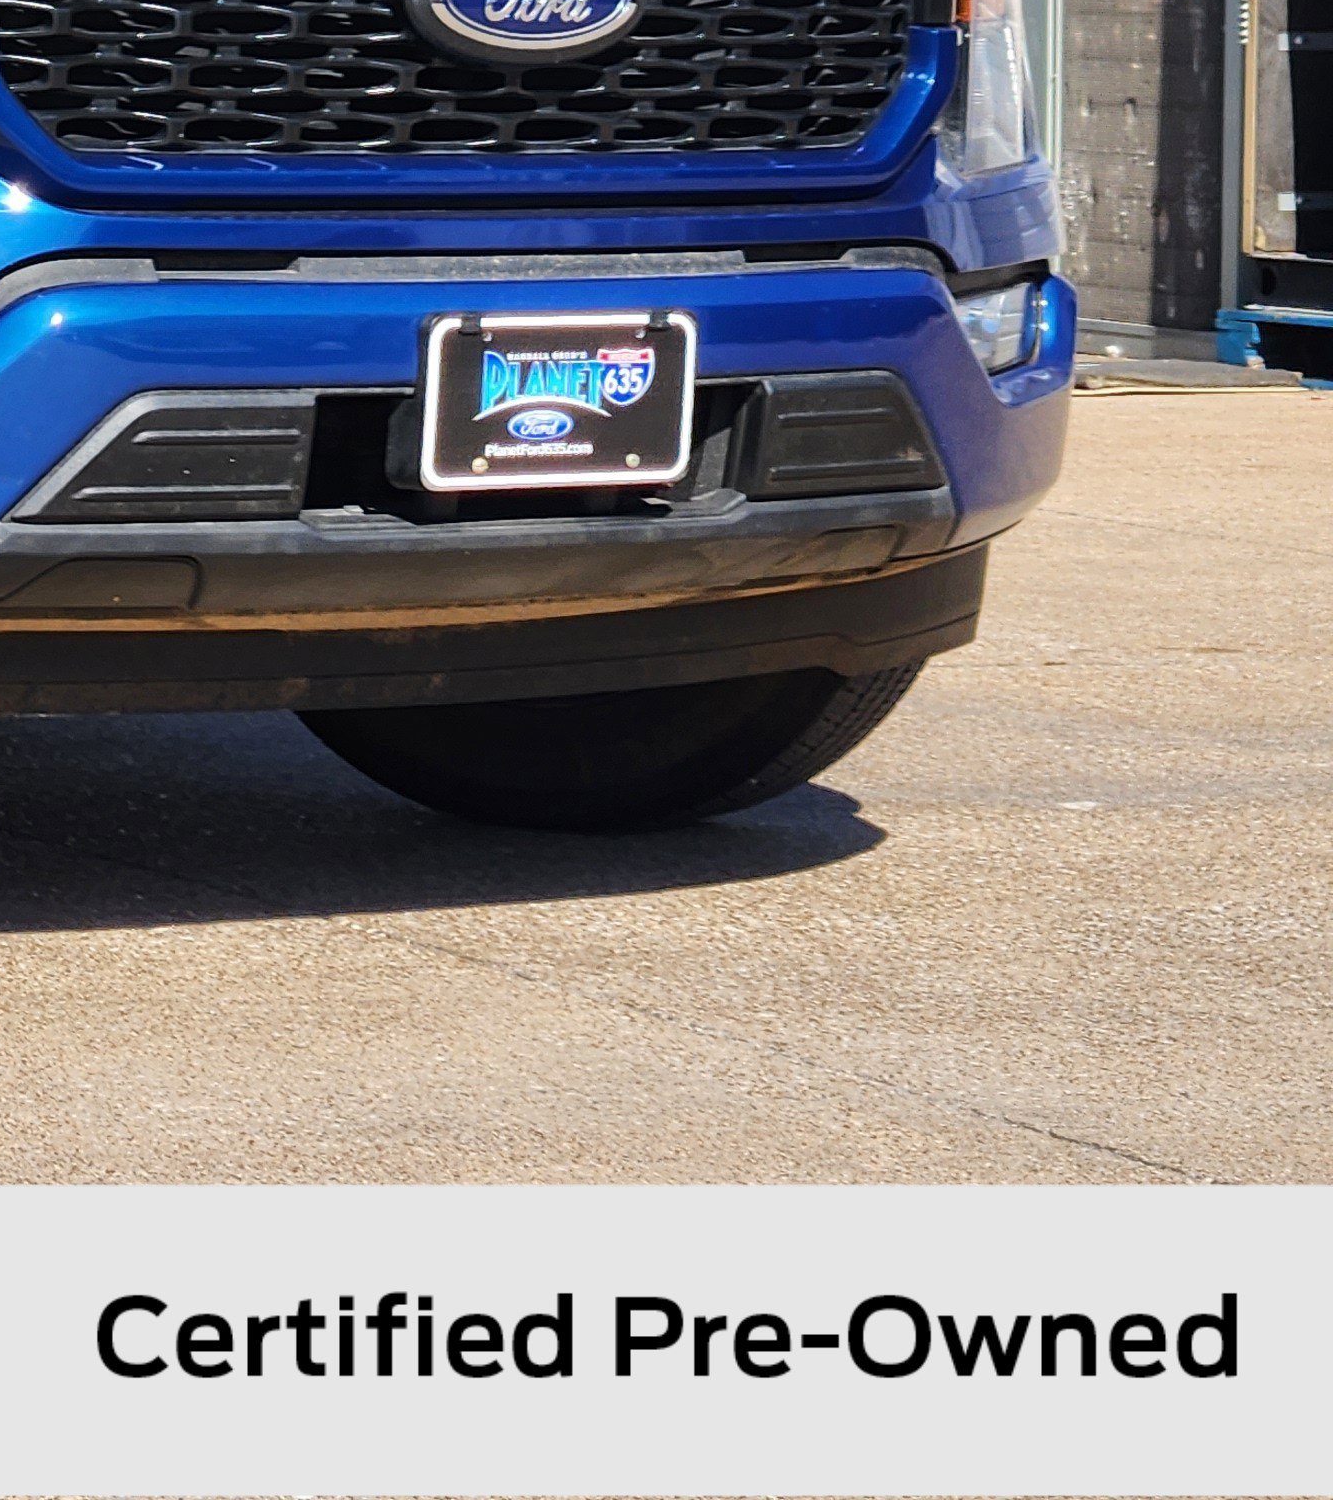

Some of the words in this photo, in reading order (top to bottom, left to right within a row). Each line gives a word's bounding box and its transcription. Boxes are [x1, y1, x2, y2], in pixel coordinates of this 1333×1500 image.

[480, 351, 605, 412] PLANET
[603, 367, 645, 394] 635
[519, 416, 559, 435] Ford
